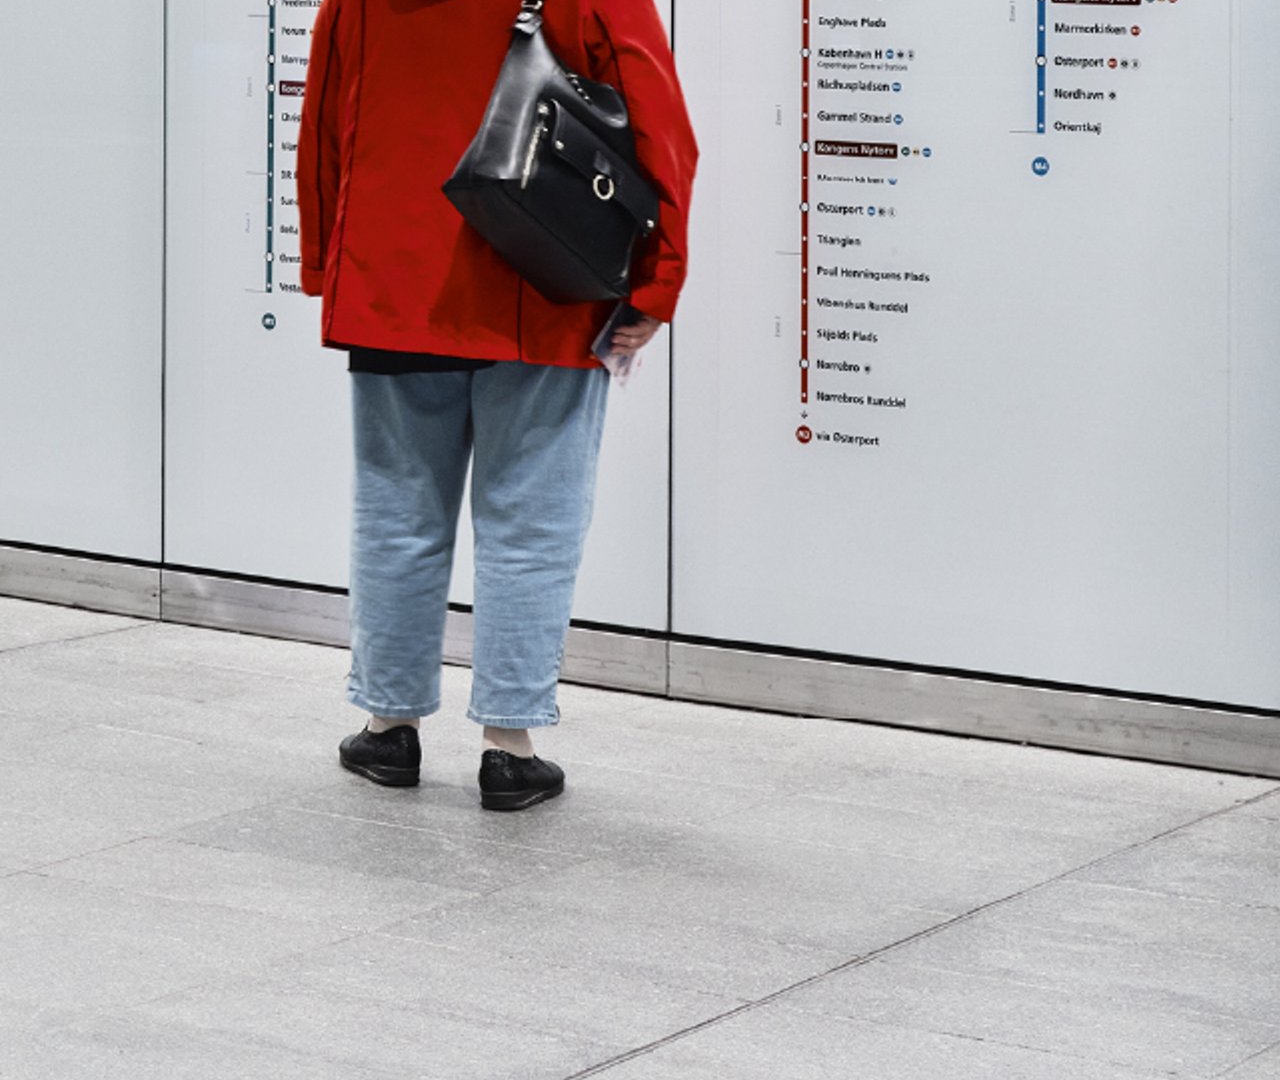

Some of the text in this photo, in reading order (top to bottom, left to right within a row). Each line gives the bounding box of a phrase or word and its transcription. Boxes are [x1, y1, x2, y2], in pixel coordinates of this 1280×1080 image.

[1055, 23, 1126, 35] Marmorkirken
[818, 49, 882, 59] København H
[1054, 88, 1104, 100] Nordhavn
